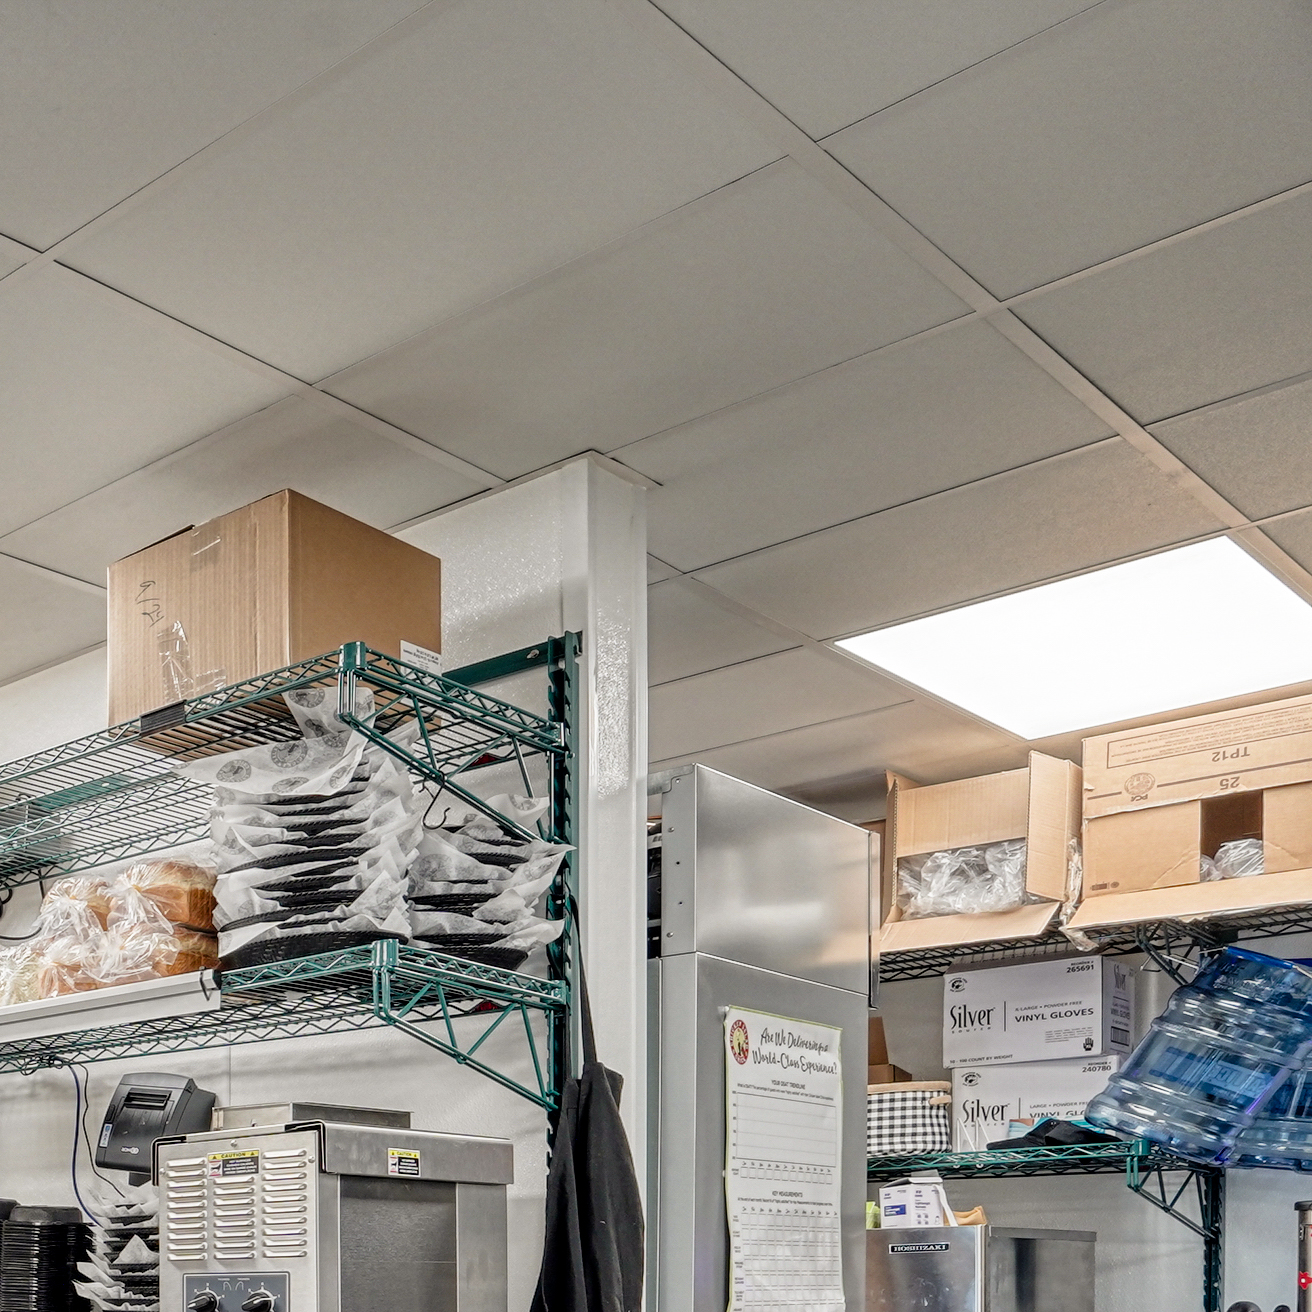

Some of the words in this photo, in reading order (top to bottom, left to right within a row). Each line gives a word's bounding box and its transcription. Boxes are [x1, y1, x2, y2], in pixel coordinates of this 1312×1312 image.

[1212, 746, 1251, 763] TP12
[1220, 776, 1241, 790] 25
[1066, 964, 1095, 973] 265691
[950, 1004, 994, 1030] Silver
[1015, 1013, 1047, 1023] VINYL
[1050, 1008, 1095, 1020] GLOVES
[760, 1027, 774, 1046] Are
[775, 1029, 786, 1047] We
[1082, 1065, 1112, 1073] 240780
[962, 1099, 1008, 1124] Silver
[893, 1244, 946, 1252] HOSHIZAKI
